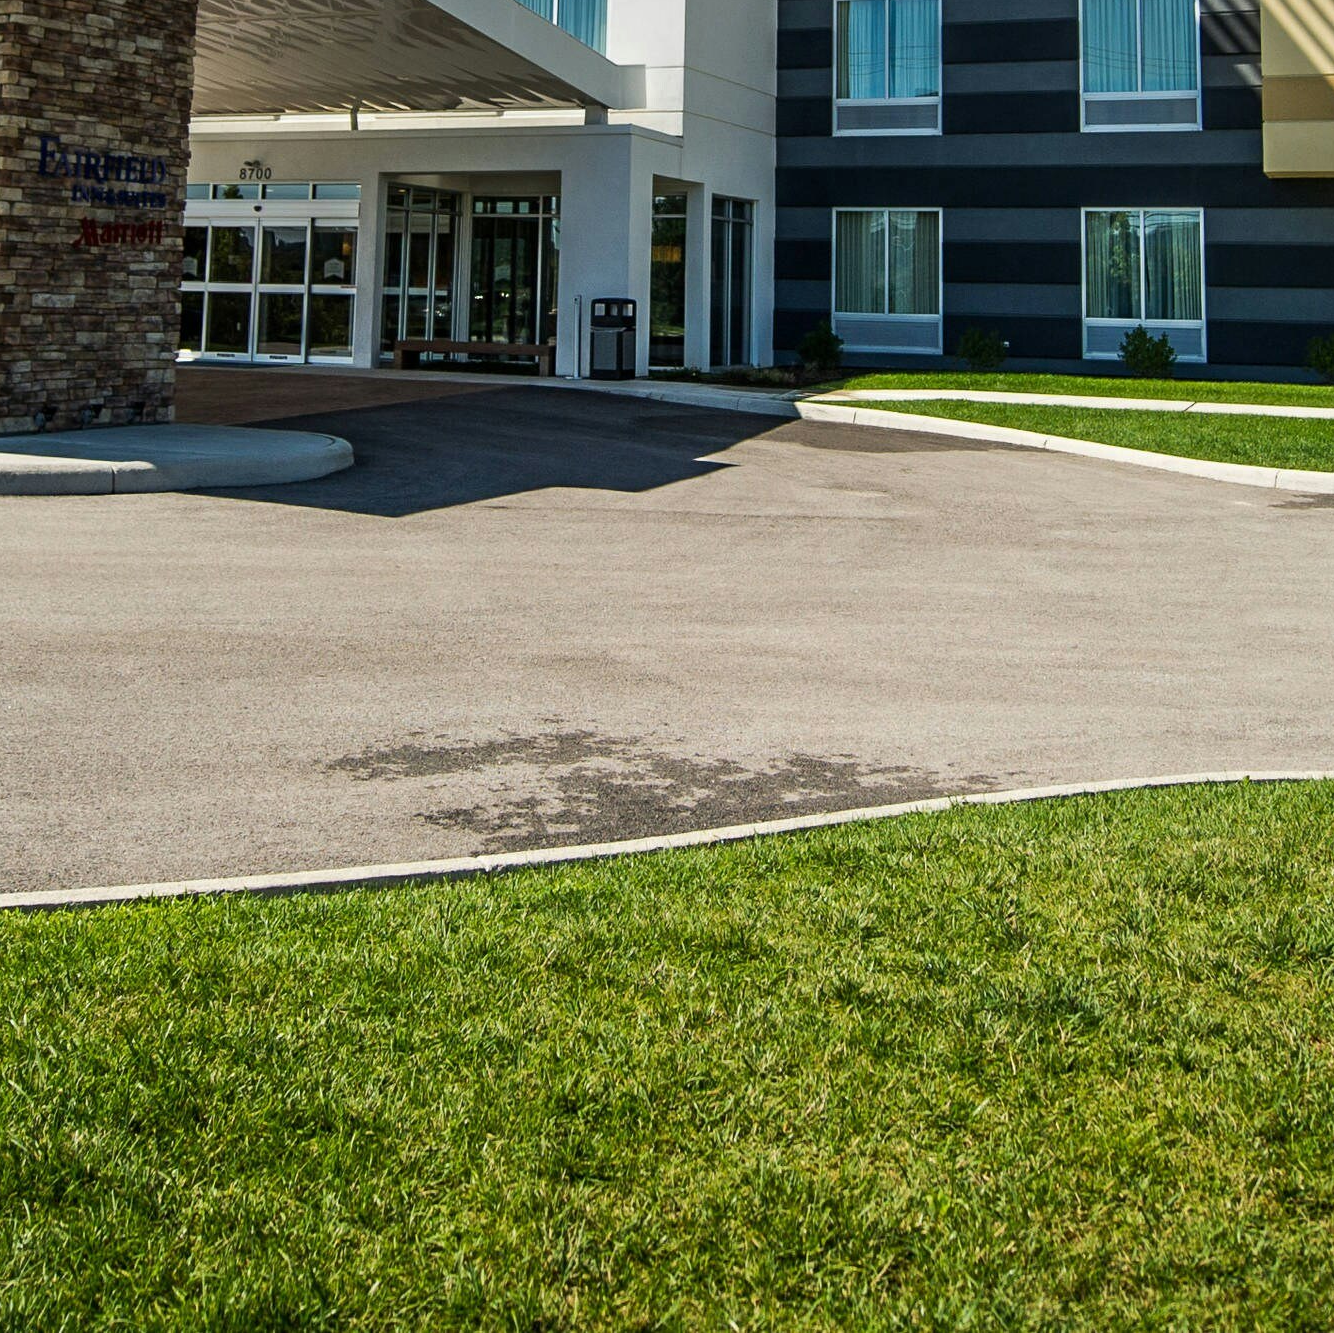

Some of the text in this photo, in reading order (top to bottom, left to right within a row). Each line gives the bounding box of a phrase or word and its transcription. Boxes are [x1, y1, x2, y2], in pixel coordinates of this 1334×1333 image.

[39, 135, 167, 184] FAIRFIELD
[239, 167, 272, 180] 8700
[72, 216, 163, 248] Marriott
